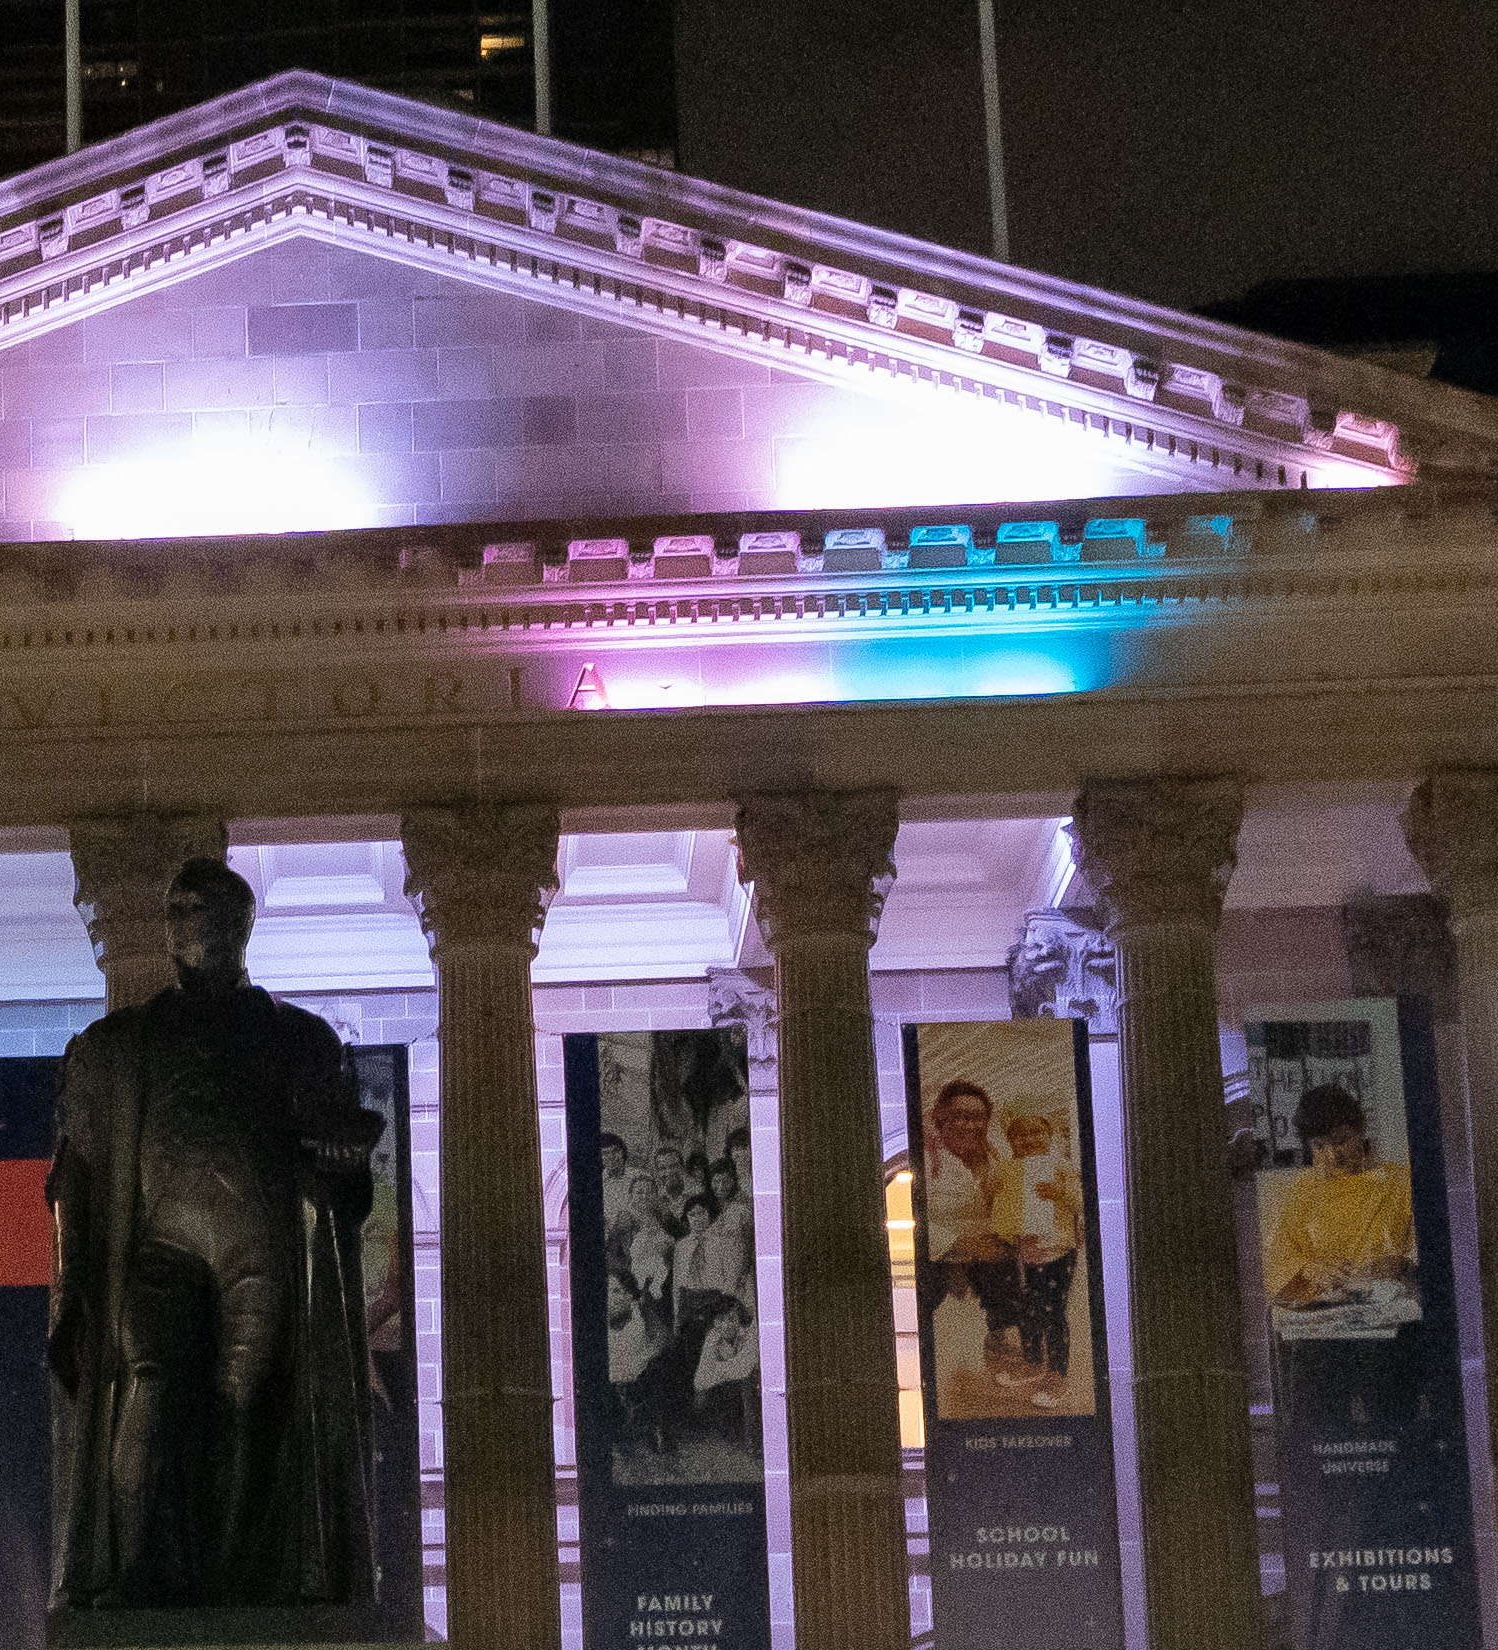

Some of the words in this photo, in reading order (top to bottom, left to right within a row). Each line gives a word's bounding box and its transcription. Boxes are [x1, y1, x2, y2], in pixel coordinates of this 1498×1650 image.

[9, 661, 606, 729] VICTORIA
[965, 1436, 997, 1449] KIDS
[1003, 1434, 1073, 1448] TAKEOVER
[1312, 1440, 1397, 1455] HANDMADE
[1322, 1459, 1390, 1475] UNIVERSE
[627, 1503, 687, 1516] FINDING
[692, 1502, 754, 1515] FAMILIES
[977, 1526, 1070, 1543] SCHOOL
[950, 1551, 1046, 1569] HOLIDAY
[1057, 1549, 1099, 1567] FUN
[1309, 1547, 1454, 1569] EXHIBITIONS
[1336, 1576, 1350, 1593] &
[1359, 1573, 1432, 1592] TOURS
[637, 1593, 714, 1612] FAMILY
[630, 1619, 723, 1637] HISTORY
